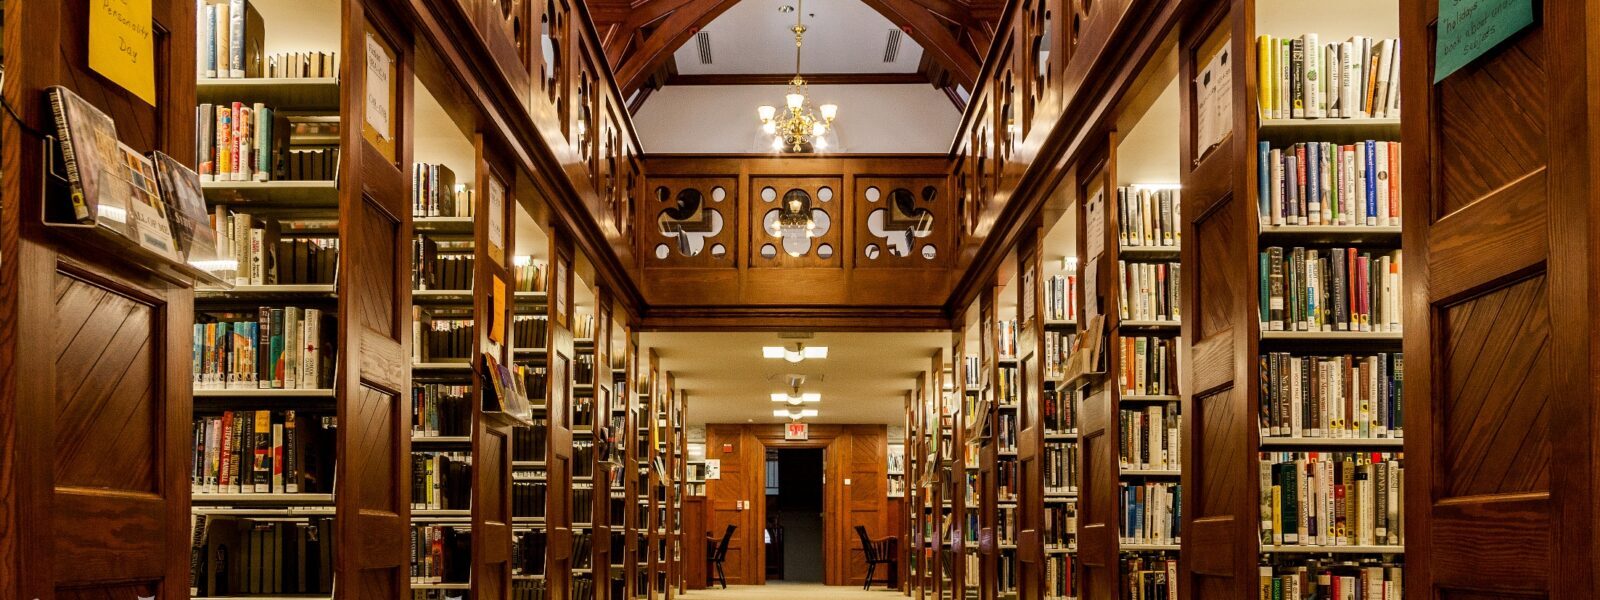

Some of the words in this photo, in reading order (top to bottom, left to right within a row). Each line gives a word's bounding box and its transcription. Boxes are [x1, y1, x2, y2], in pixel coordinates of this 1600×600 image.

[118, 35, 138, 64] Day
[224, 426, 232, 451] STEPHEN
[222, 458, 230, 482] CANNELL
